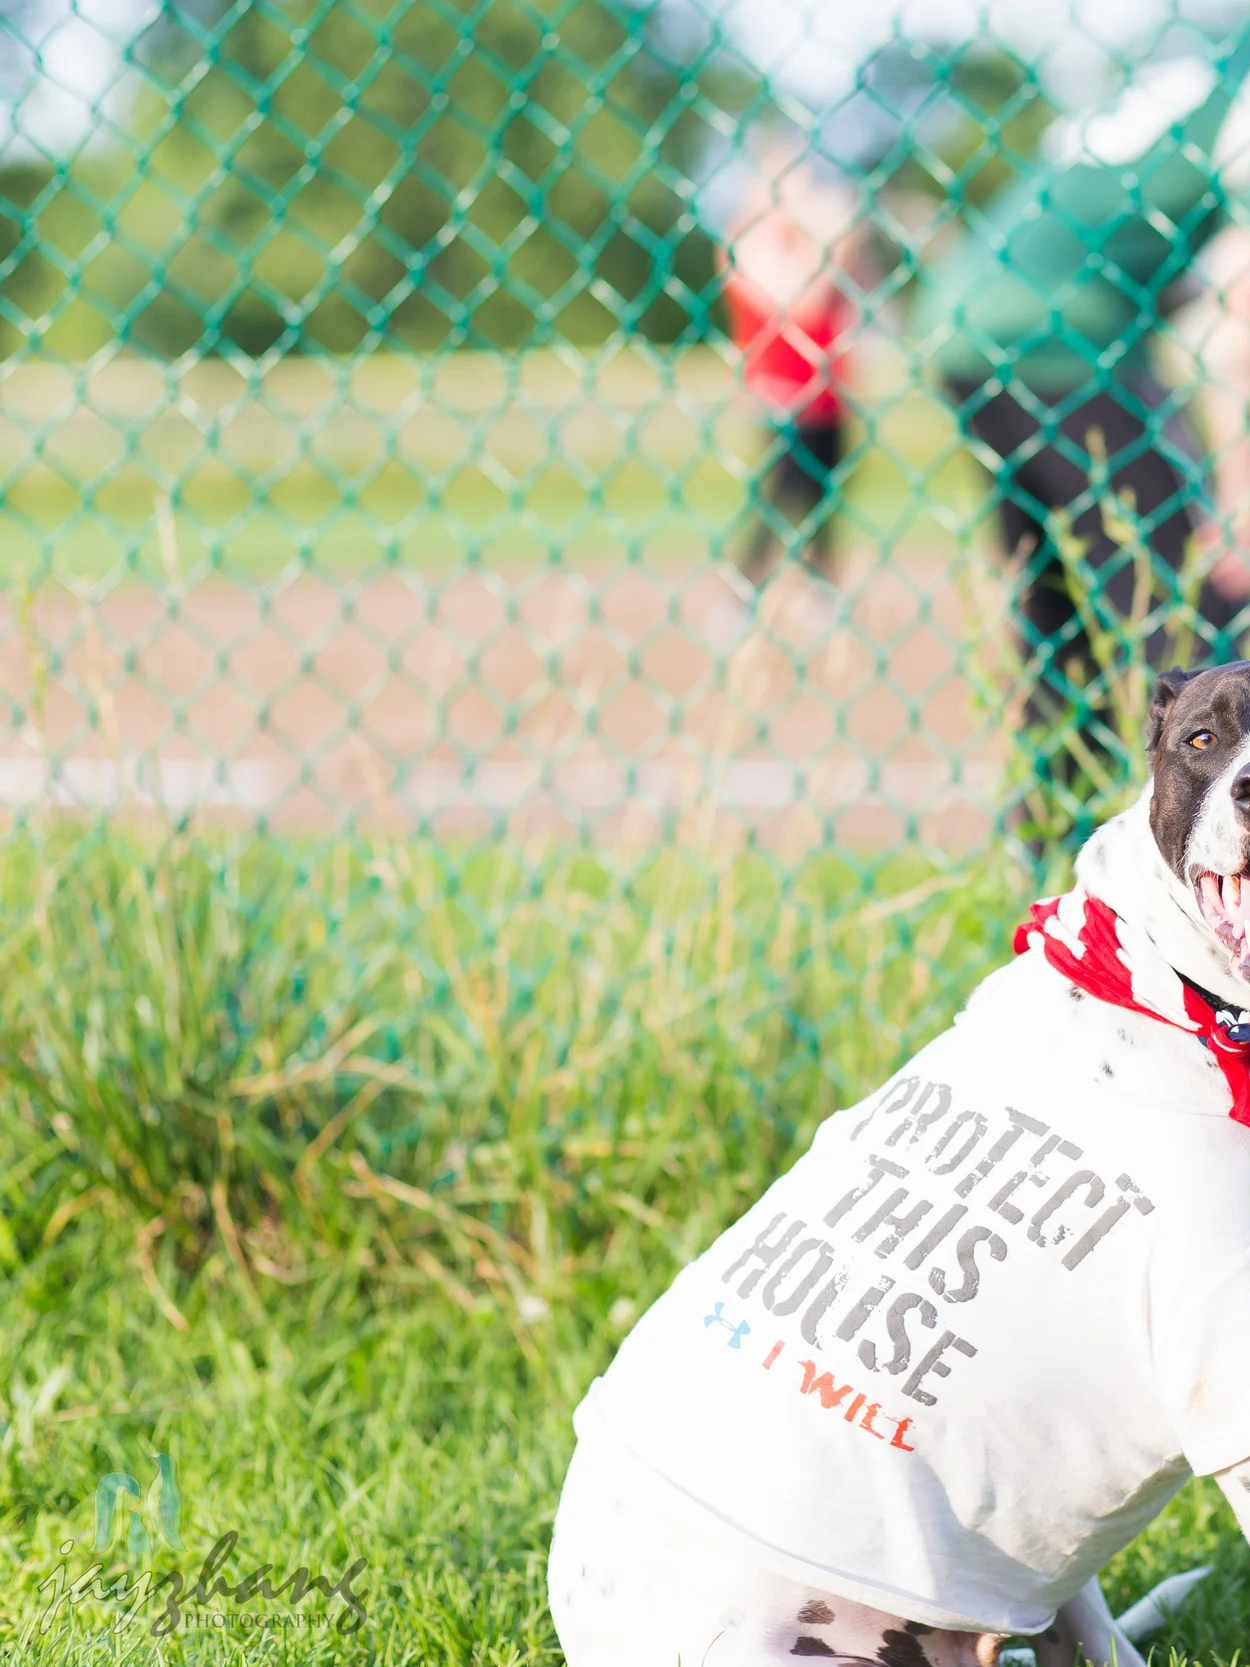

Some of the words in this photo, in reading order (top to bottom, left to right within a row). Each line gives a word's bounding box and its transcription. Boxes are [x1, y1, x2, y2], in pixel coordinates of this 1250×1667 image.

[823, 1154, 1007, 1303] THIS
[850, 1075, 1155, 1271] PROTECT
[721, 1212, 978, 1407] HOUSE
[762, 1340, 785, 1370] I
[797, 1359, 916, 1452] WILL
